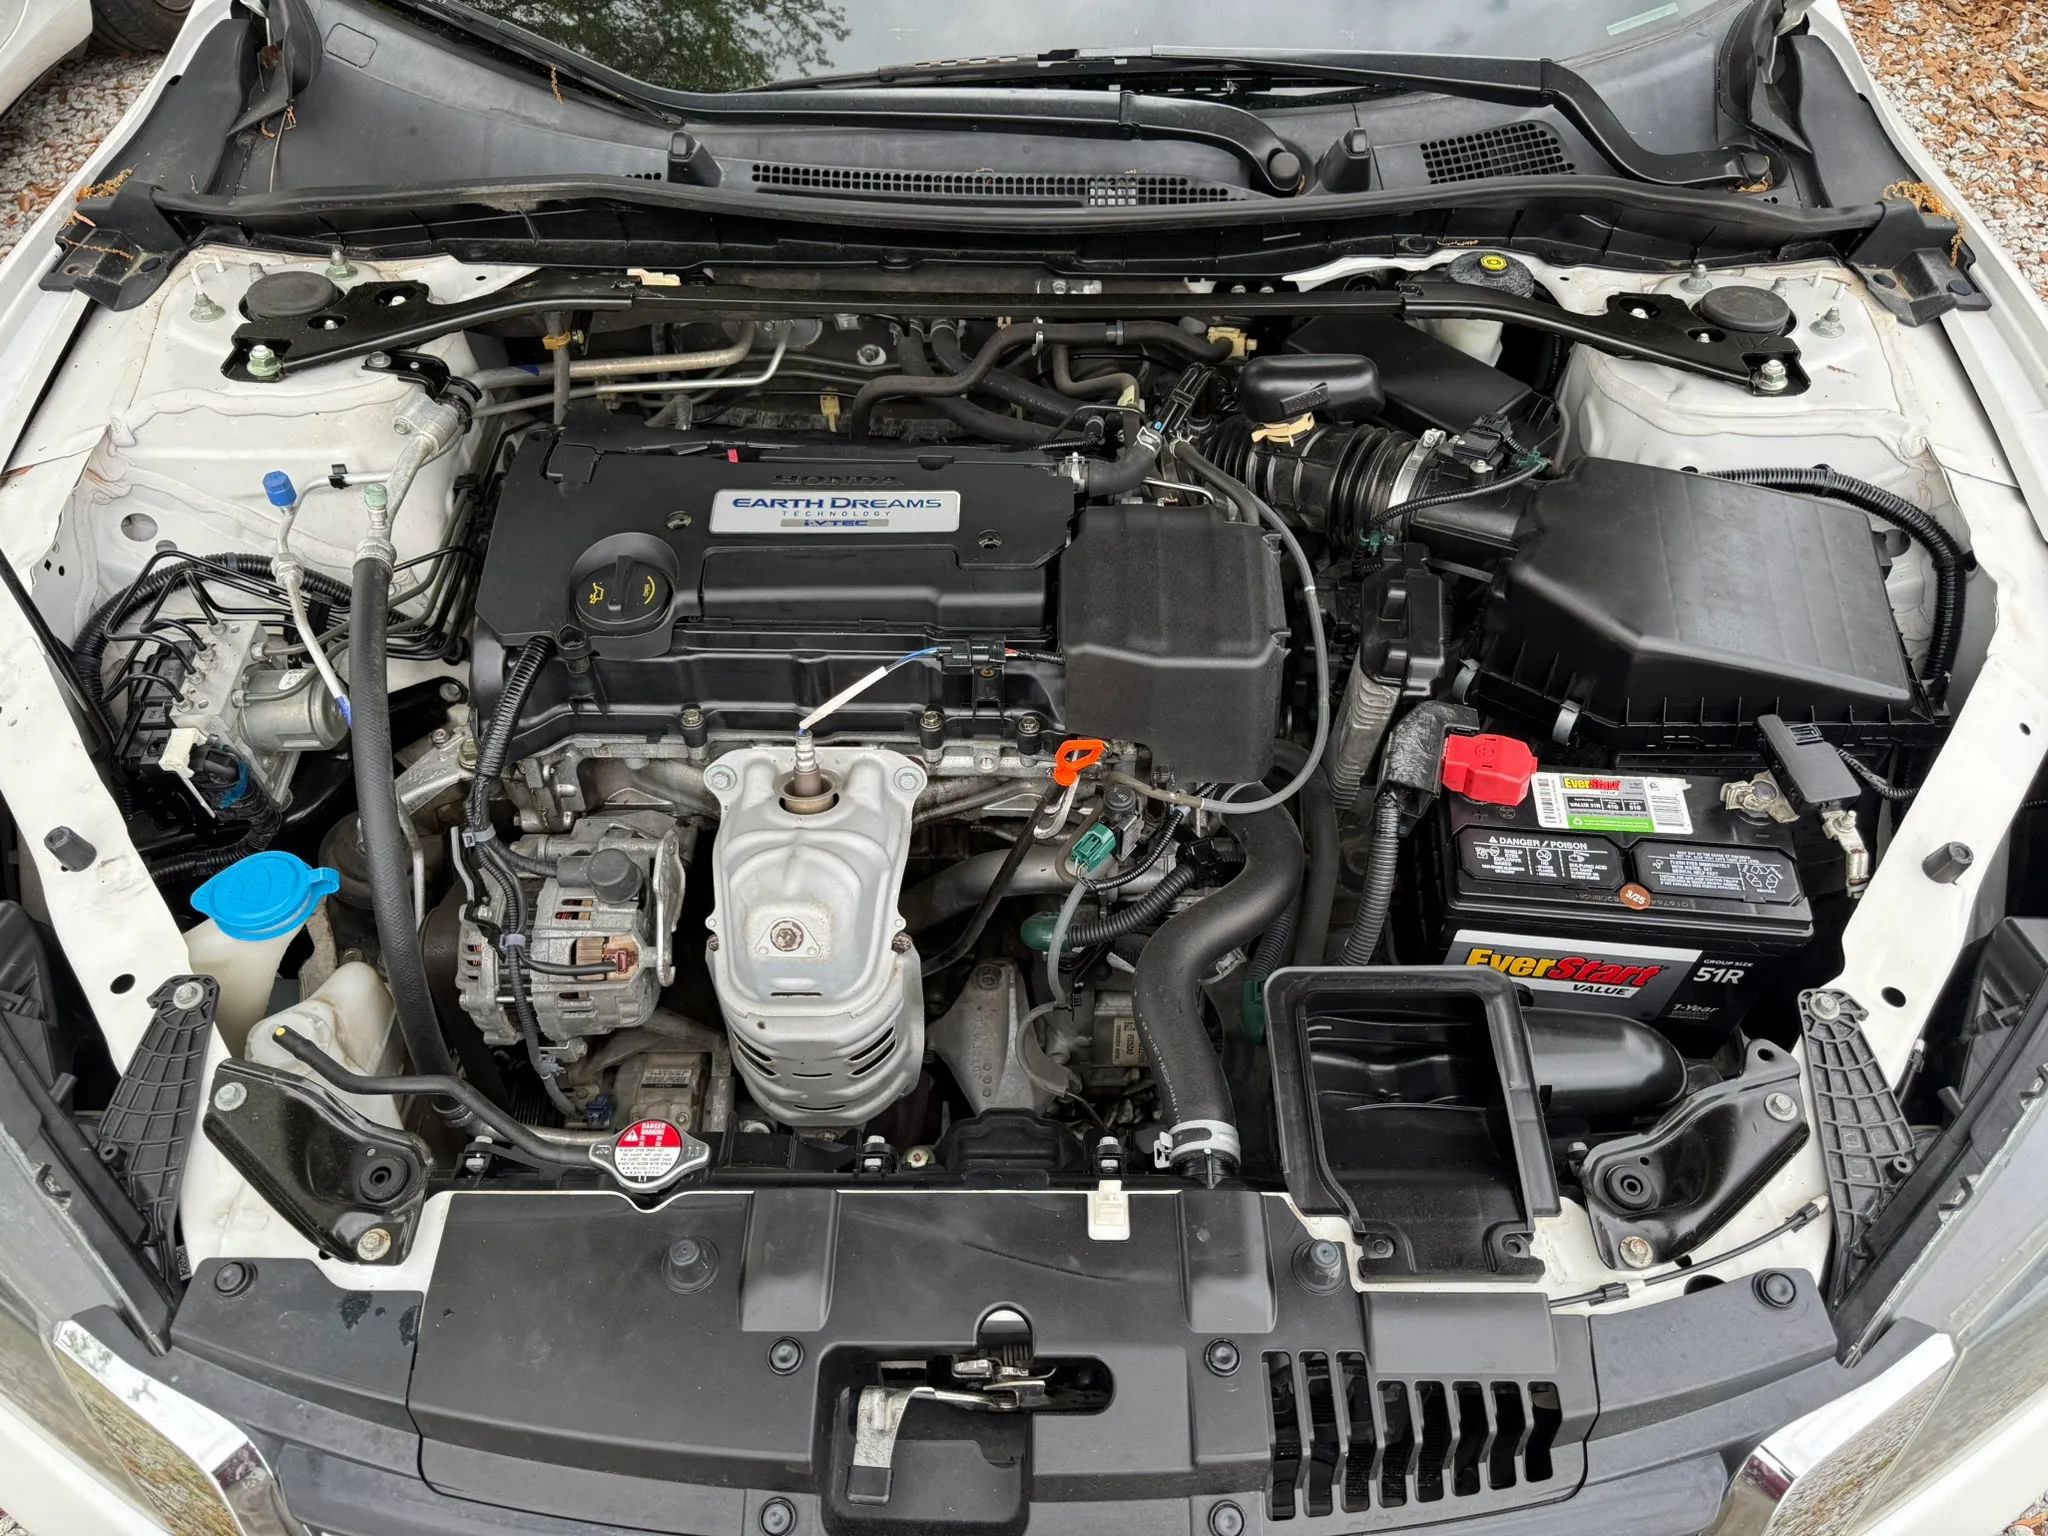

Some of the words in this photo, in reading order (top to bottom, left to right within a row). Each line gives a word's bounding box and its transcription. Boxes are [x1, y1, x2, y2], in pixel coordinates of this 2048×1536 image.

[771, 475, 904, 486] HONDA
[732, 497, 824, 509] EARTH
[831, 497, 942, 509] DREAMS
[804, 519, 868, 527] i-VTEC
[1564, 777, 1620, 791] EverStart
[1499, 837, 1540, 848] DANGER
[1550, 841, 1588, 850] POISON
[1625, 889, 1646, 905] 3/25
[1466, 947, 1663, 987] EverStart
[1693, 966, 1745, 985] 51R
[1572, 983, 1629, 996] VALUE
[1673, 1003, 1720, 1013] 1-Year
